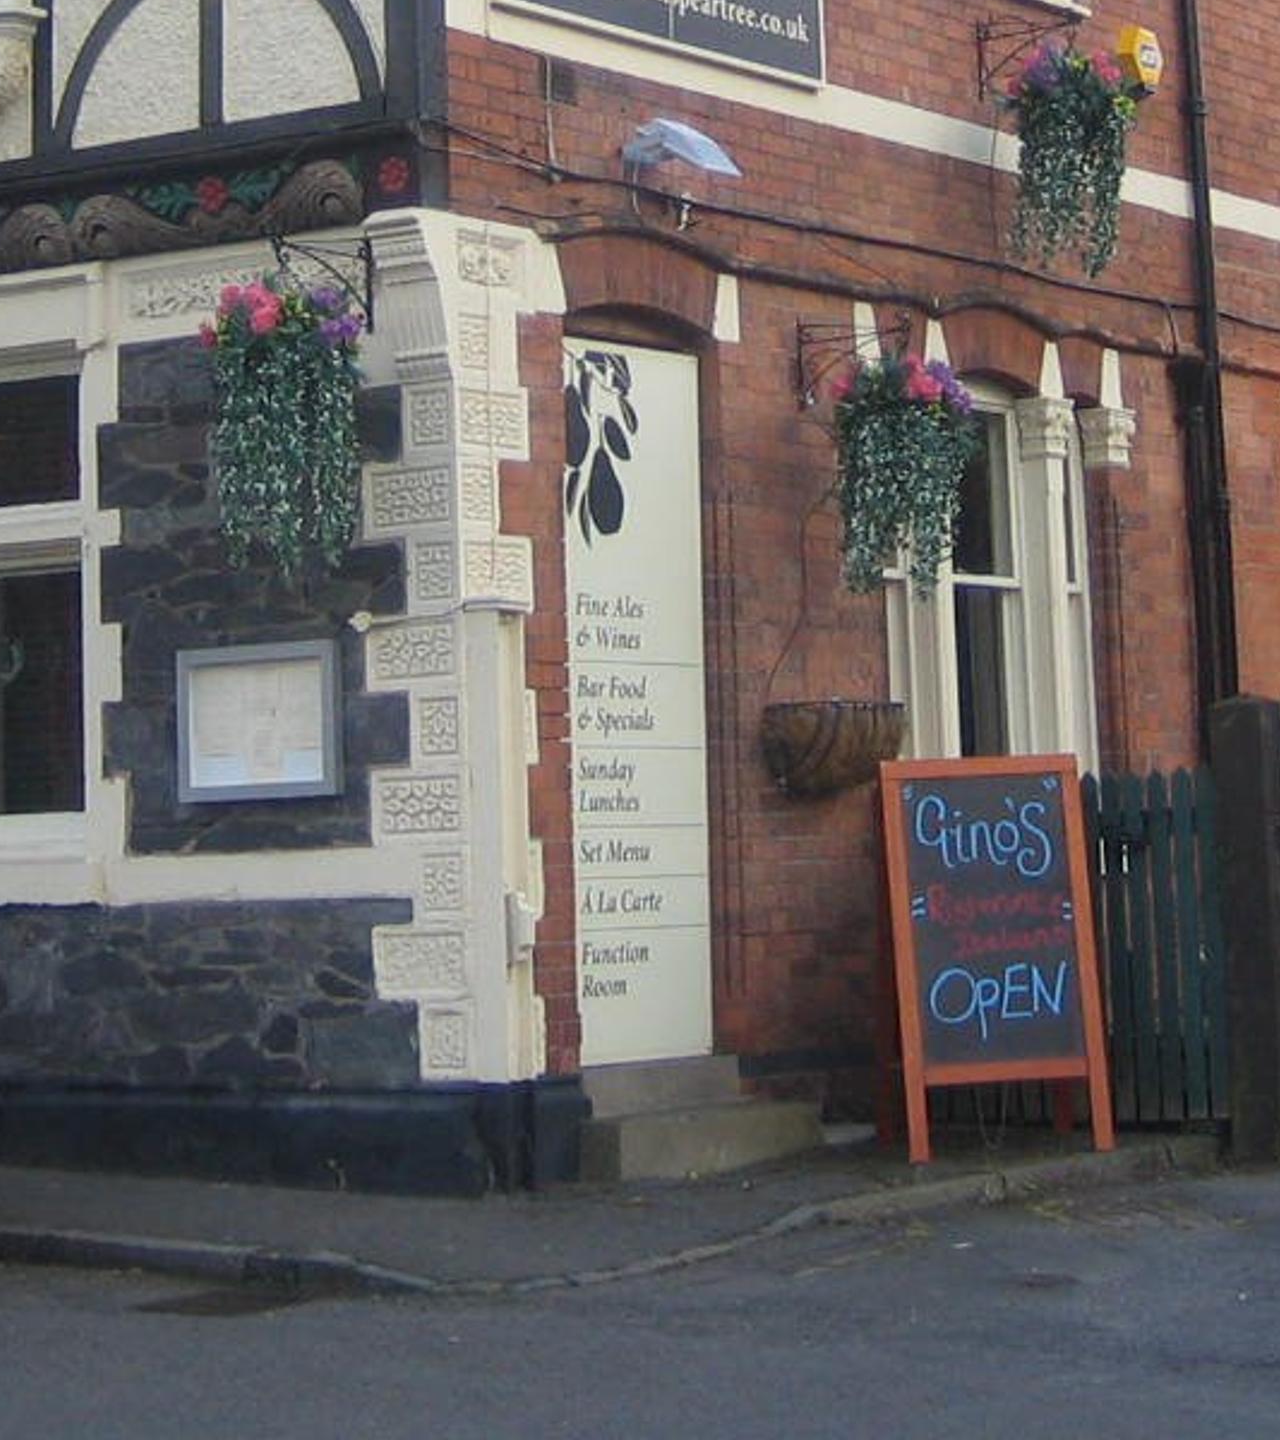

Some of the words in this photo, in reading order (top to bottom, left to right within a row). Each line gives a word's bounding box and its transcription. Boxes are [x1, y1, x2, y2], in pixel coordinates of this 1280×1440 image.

[576, 593, 610, 617] Fine
[612, 596, 644, 619] Ales
[576, 629, 591, 647] &
[594, 627, 641, 650] Wines
[577, 675, 605, 698] Bar
[609, 676, 647, 699] Food
[577, 710, 593, 729] &
[596, 708, 655, 738] Specials
[578, 758, 636, 787] Sunday
[579, 789, 640, 812] Lunches
[579, 841, 602, 863] Set
[606, 841, 650, 862] Menu
[599, 890, 617, 912] La
[621, 889, 663, 912] Carte
[582, 941, 649, 965] Function
[583, 975, 627, 998] Room
